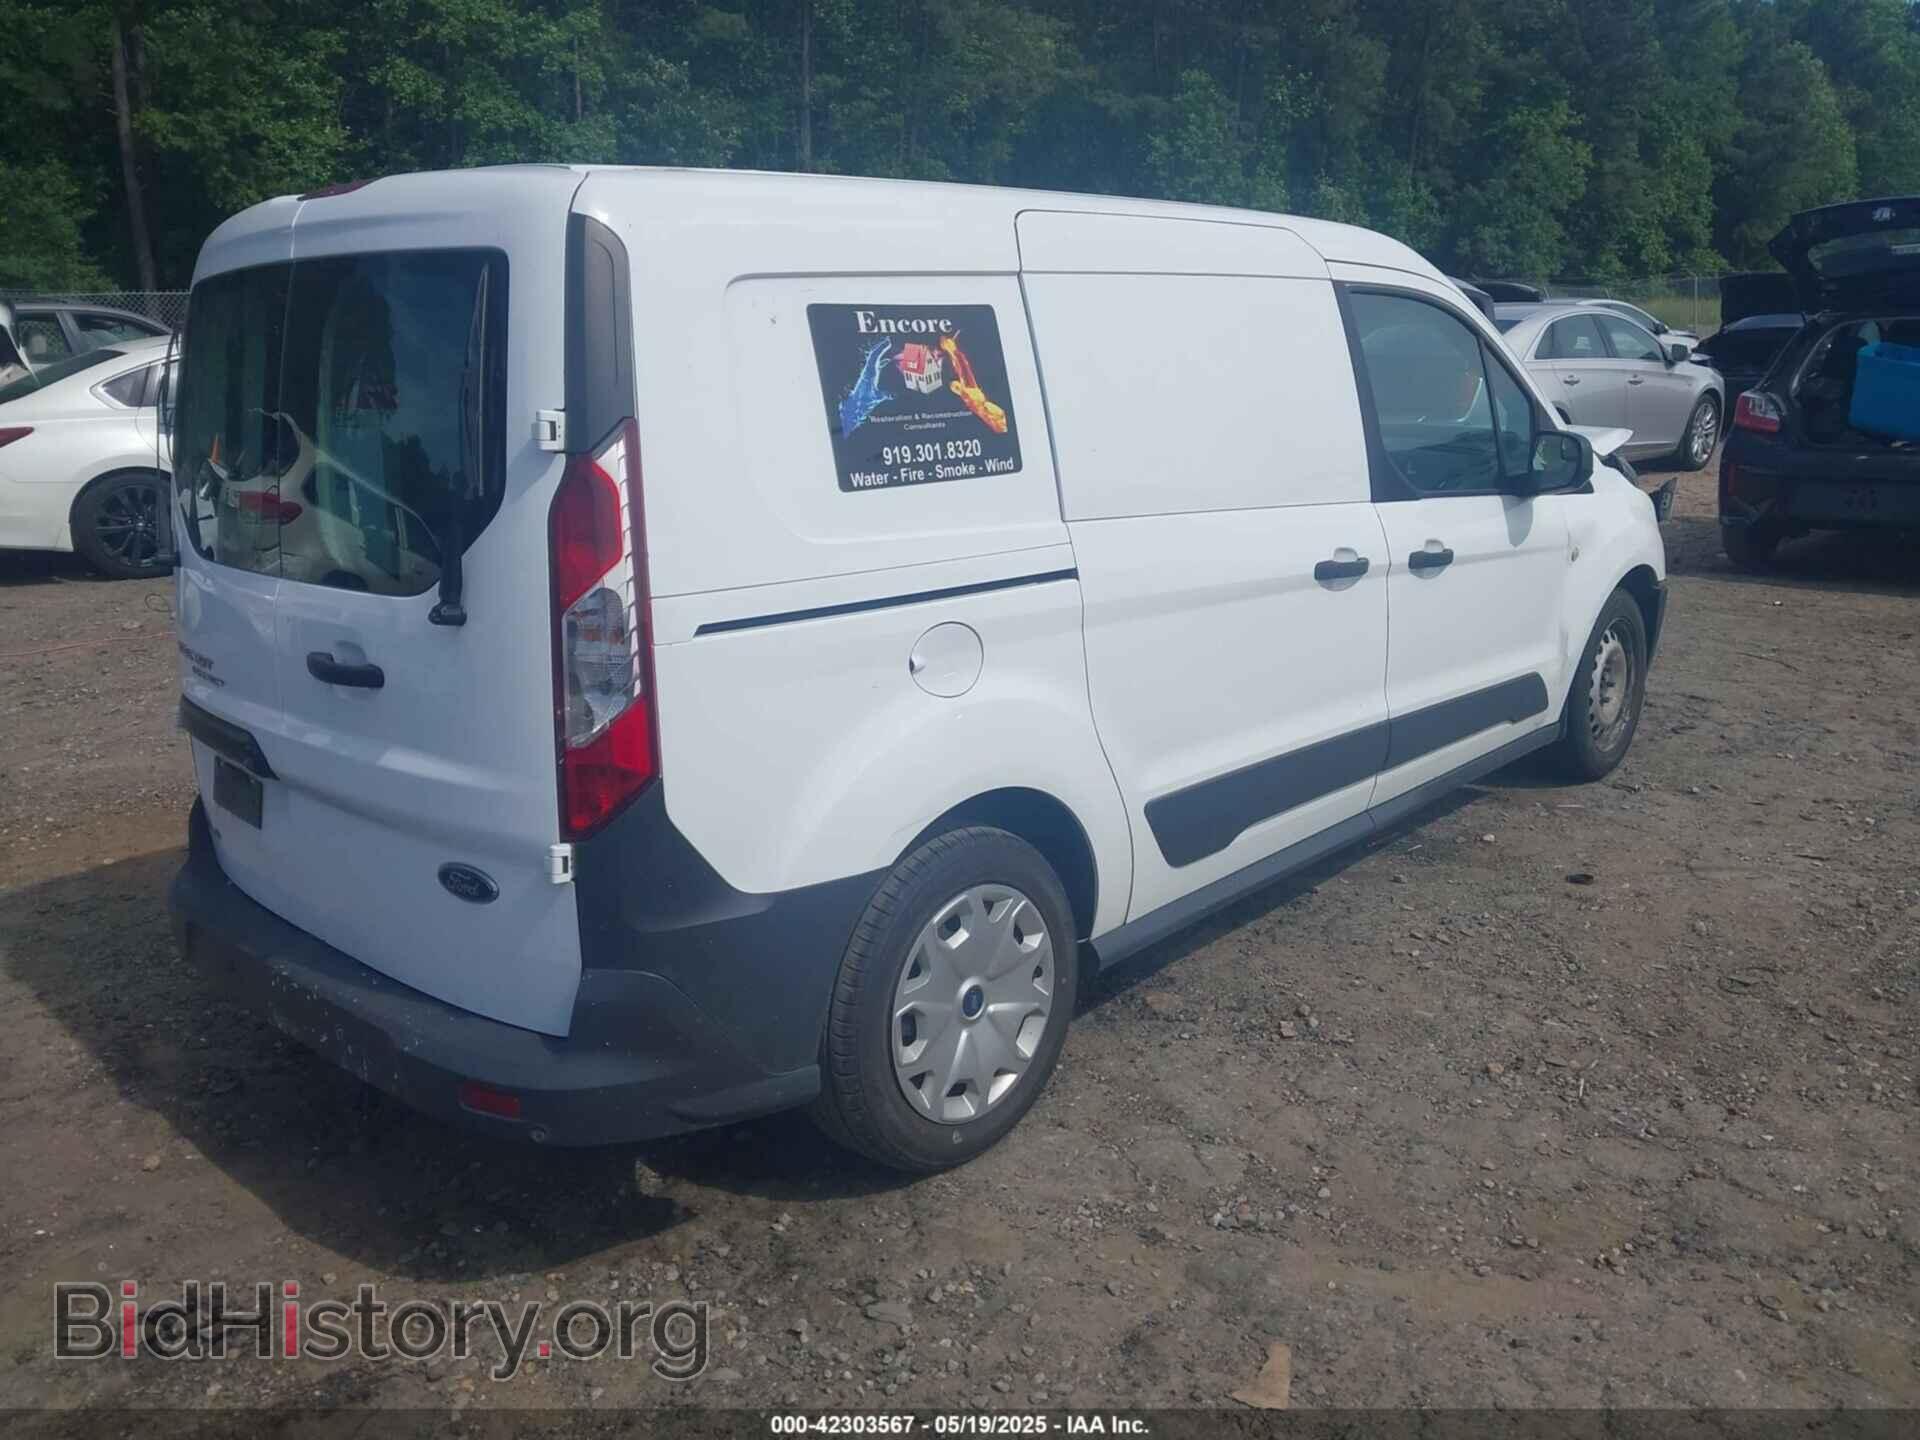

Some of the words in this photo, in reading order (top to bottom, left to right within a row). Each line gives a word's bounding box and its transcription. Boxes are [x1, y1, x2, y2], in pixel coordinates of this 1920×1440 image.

[855, 310, 953, 334] Encore
[882, 438, 981, 465] 919.301.8320
[850, 470, 889, 488] Water
[900, 467, 925, 482] Fire
[935, 462, 976, 480] Smoke
[985, 457, 1014, 473] Wind
